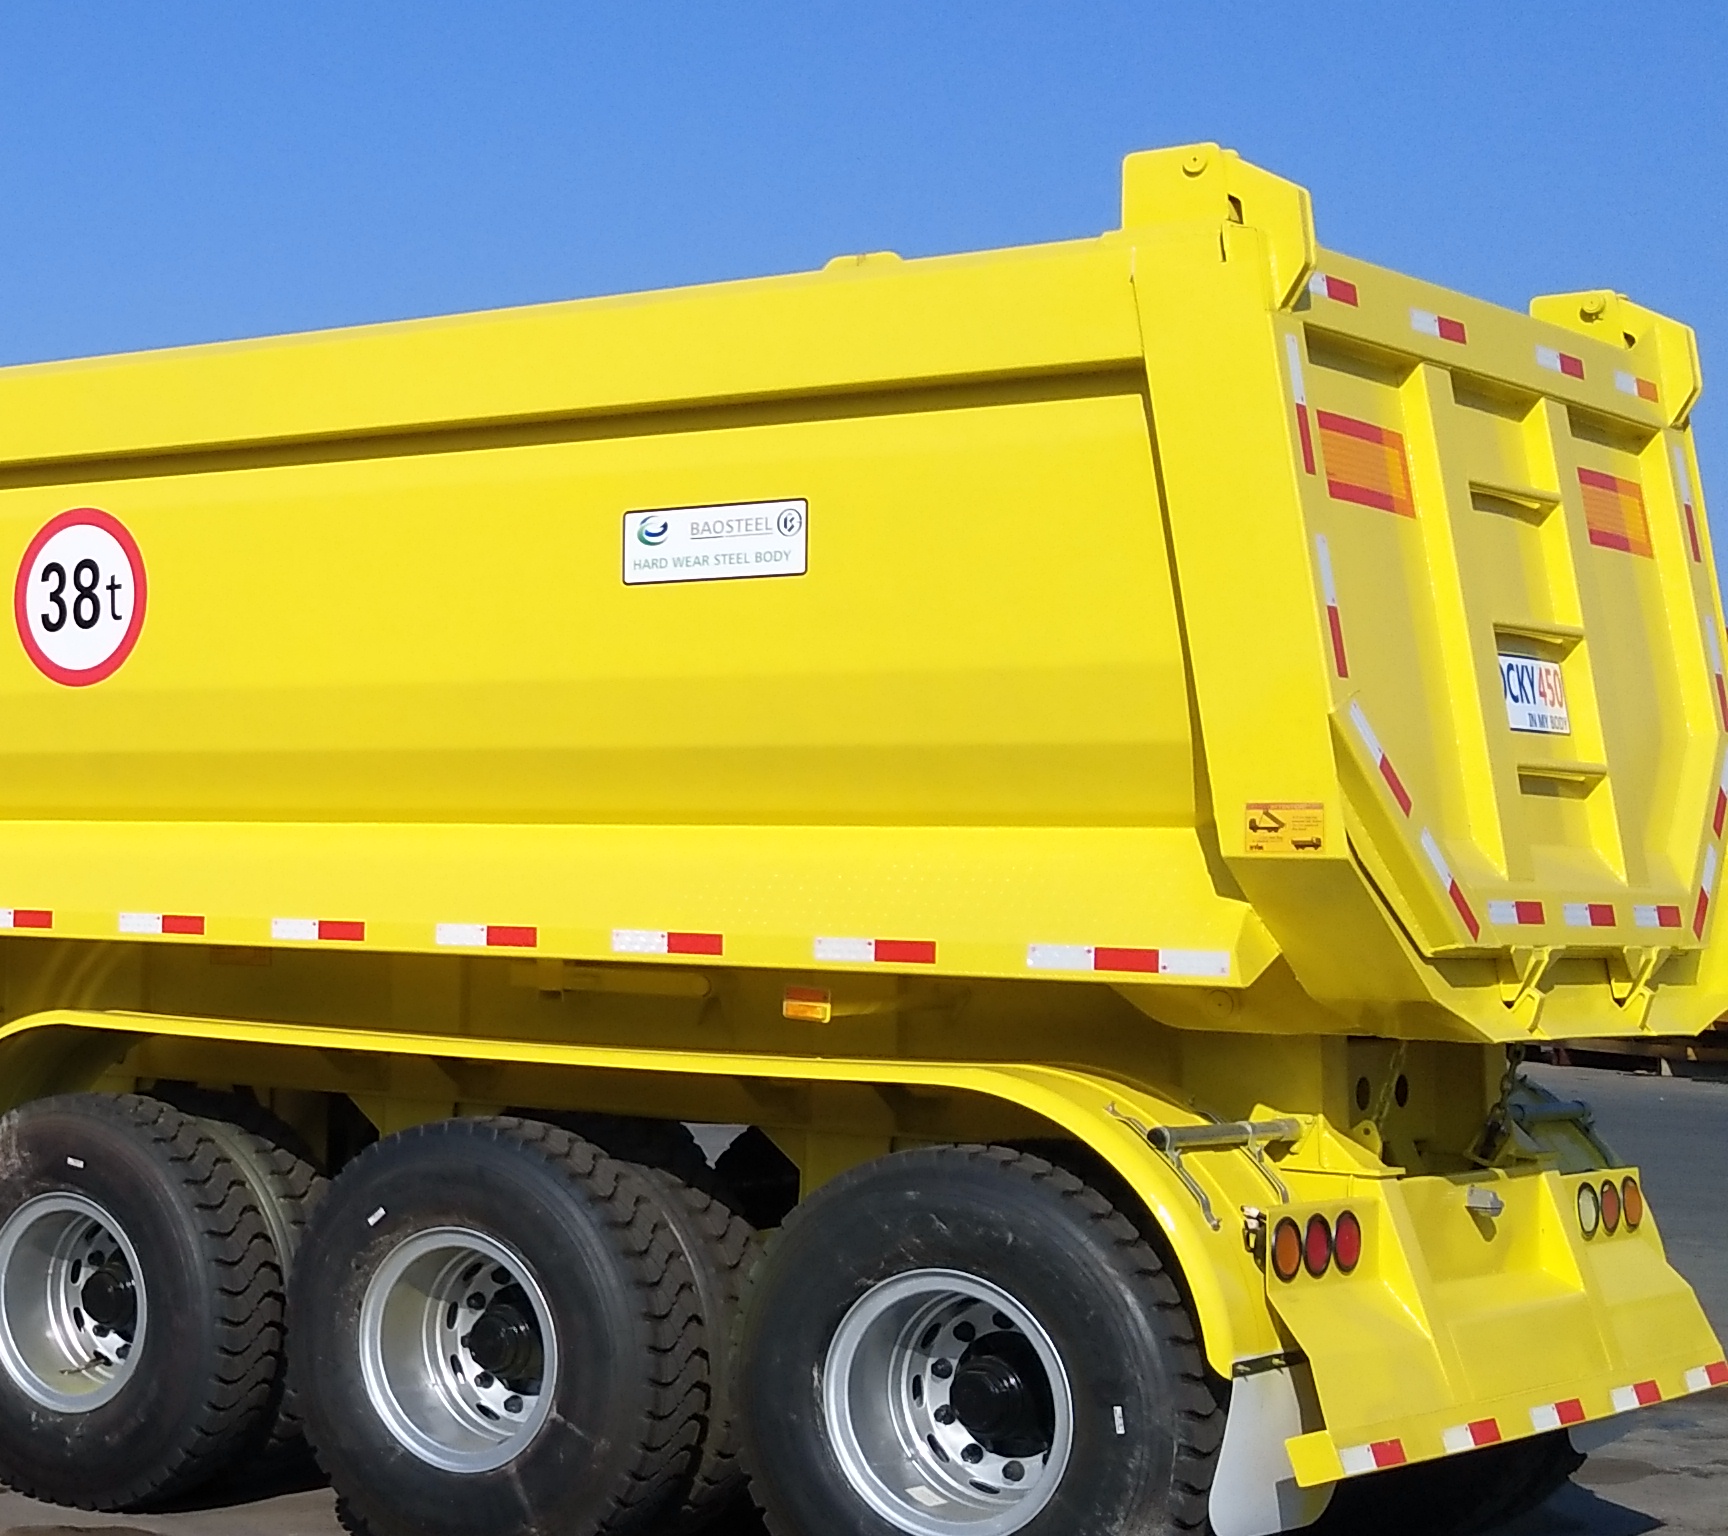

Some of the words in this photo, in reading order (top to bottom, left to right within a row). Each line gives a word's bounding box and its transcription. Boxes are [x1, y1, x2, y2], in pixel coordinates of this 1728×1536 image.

[690, 517, 773, 536] BAOSTEEL
[633, 557, 669, 570] HARD
[672, 554, 710, 568] WEAR
[714, 552, 750, 566] STEEL
[755, 550, 792, 563] BODY
